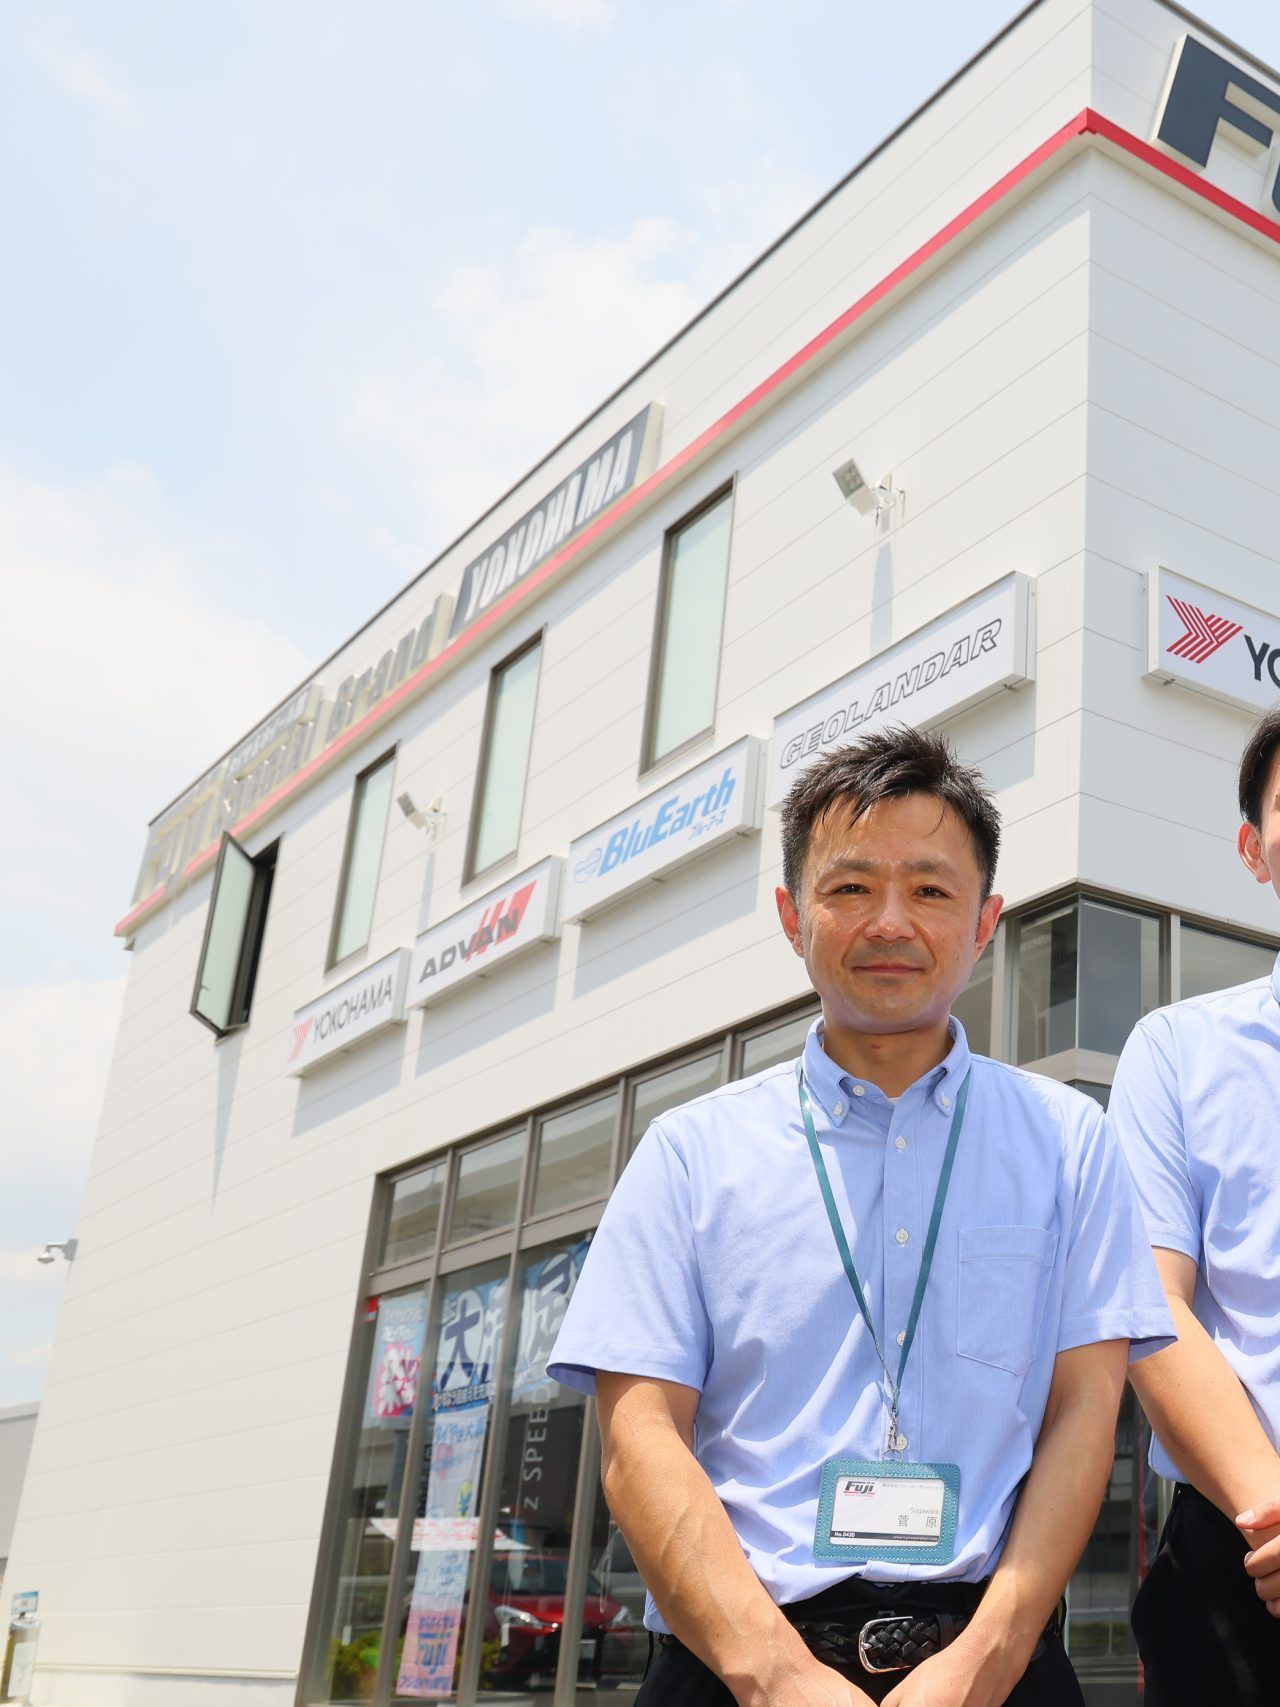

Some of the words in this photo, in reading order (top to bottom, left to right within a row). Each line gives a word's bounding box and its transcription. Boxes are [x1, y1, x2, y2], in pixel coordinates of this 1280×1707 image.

[464, 429, 633, 621] YOKOHAMA
[780, 618, 1002, 769] GEOLANDAR
[597, 767, 736, 877] BluEarth
[418, 907, 520, 984] ADVAN
[313, 974, 392, 1044] YOKOHAMA
[844, 1481, 876, 1494] Fuji
